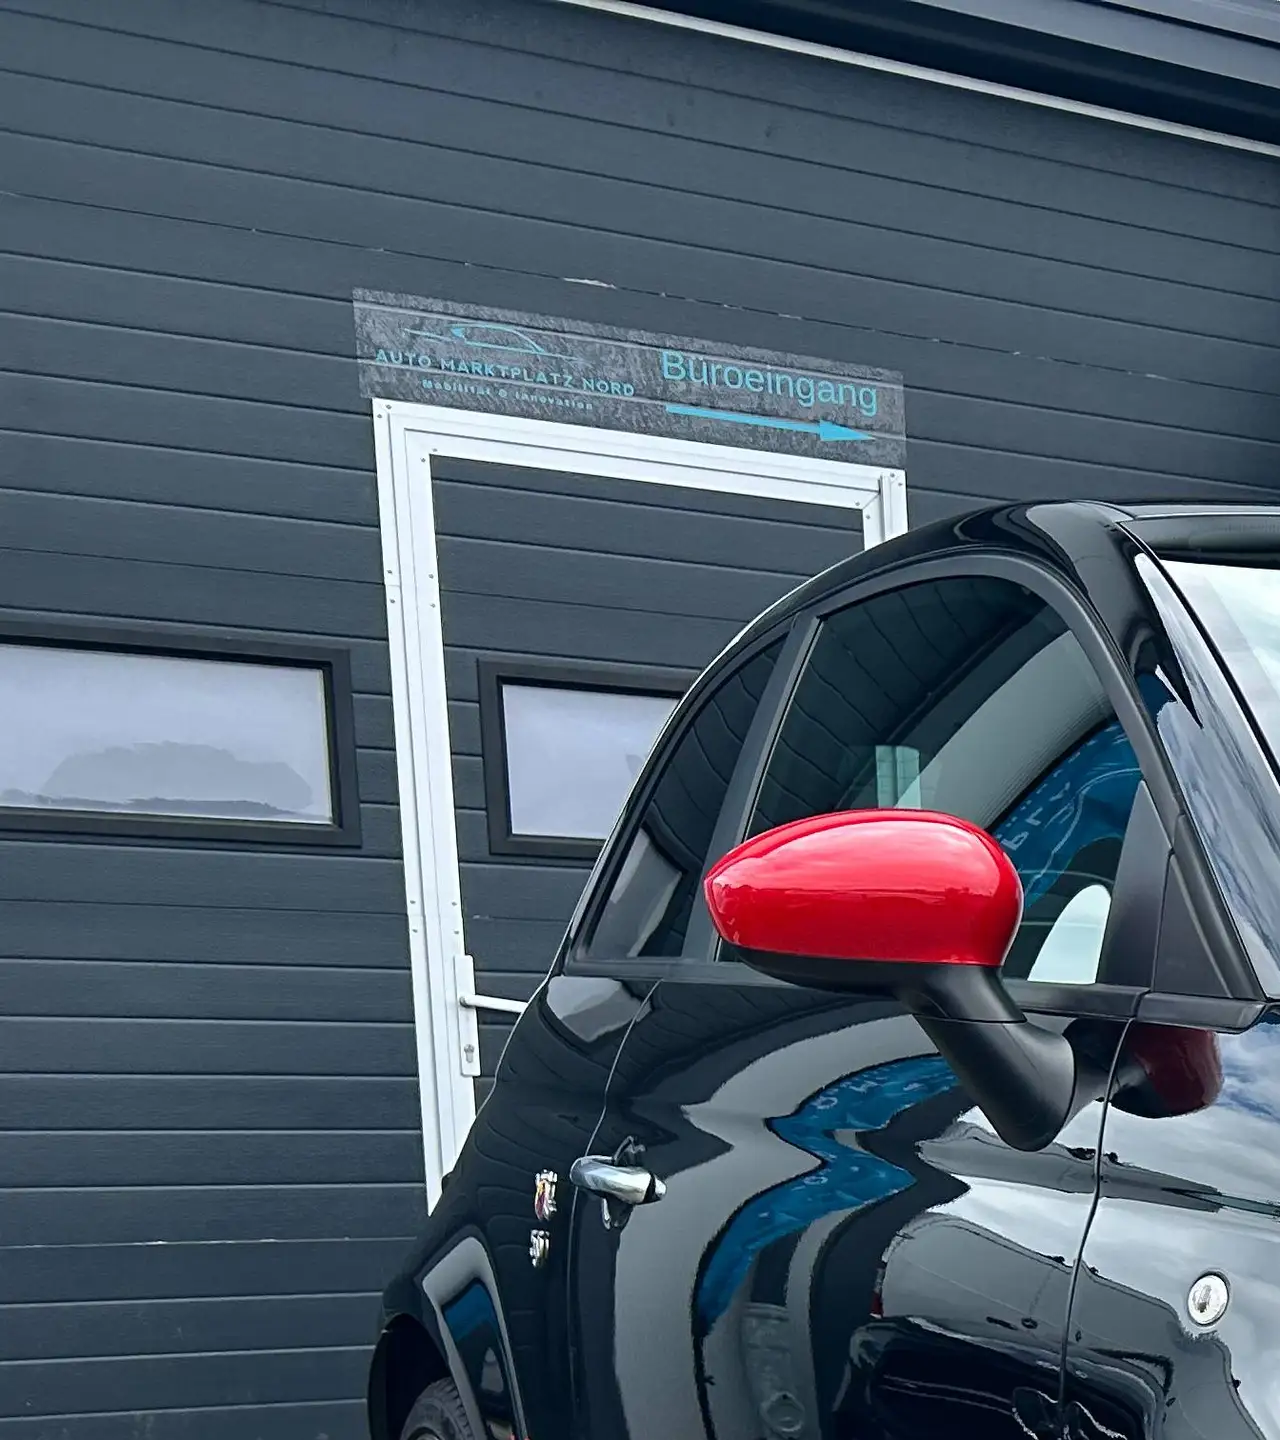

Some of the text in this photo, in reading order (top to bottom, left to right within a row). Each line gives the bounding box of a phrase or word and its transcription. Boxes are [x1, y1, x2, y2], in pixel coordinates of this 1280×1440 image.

[375, 349, 635, 397] AUTO MARKTPLATZ NORD
[660, 349, 878, 417] Büroeingang
